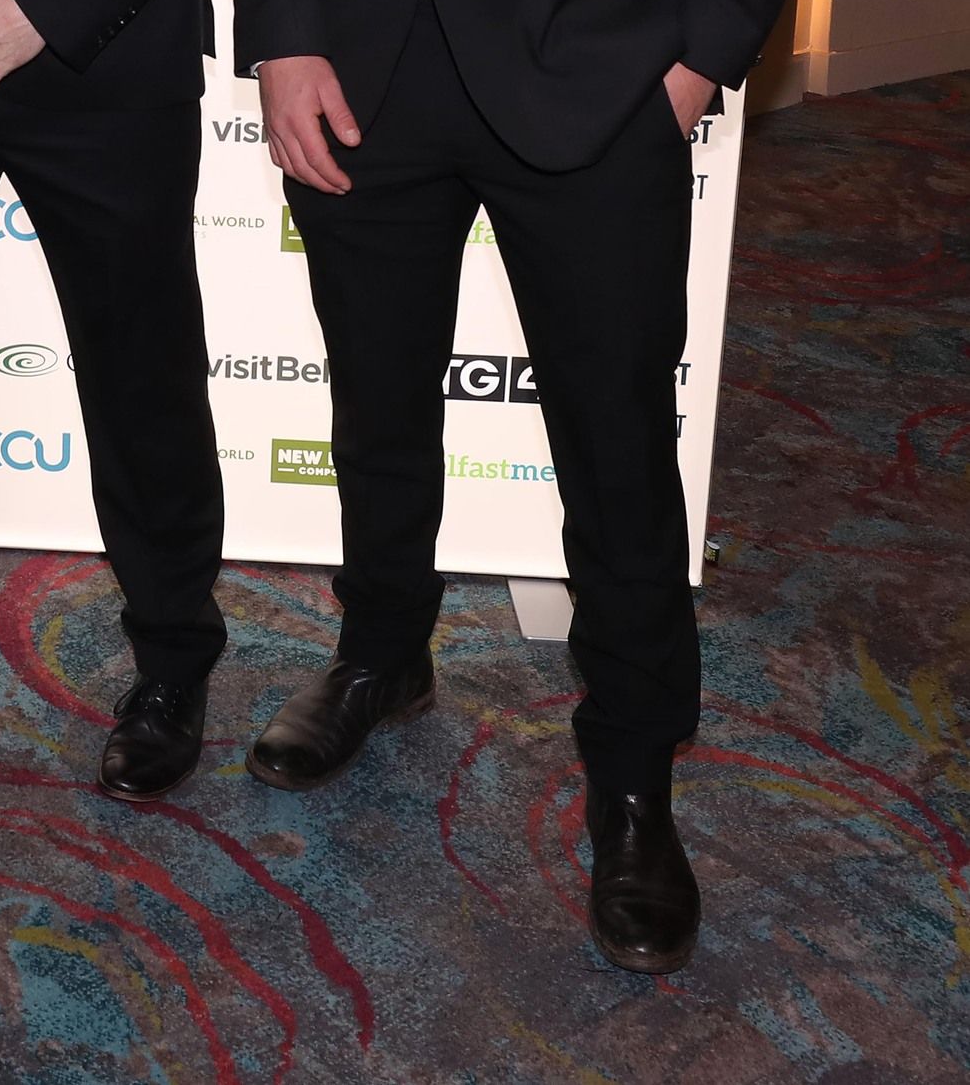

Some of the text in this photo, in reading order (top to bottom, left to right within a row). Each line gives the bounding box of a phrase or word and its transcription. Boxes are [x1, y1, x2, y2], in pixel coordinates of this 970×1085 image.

[212, 215, 266, 229] WORLD
[217, 448, 255, 461] ORLD
[278, 448, 323, 465] NEW
